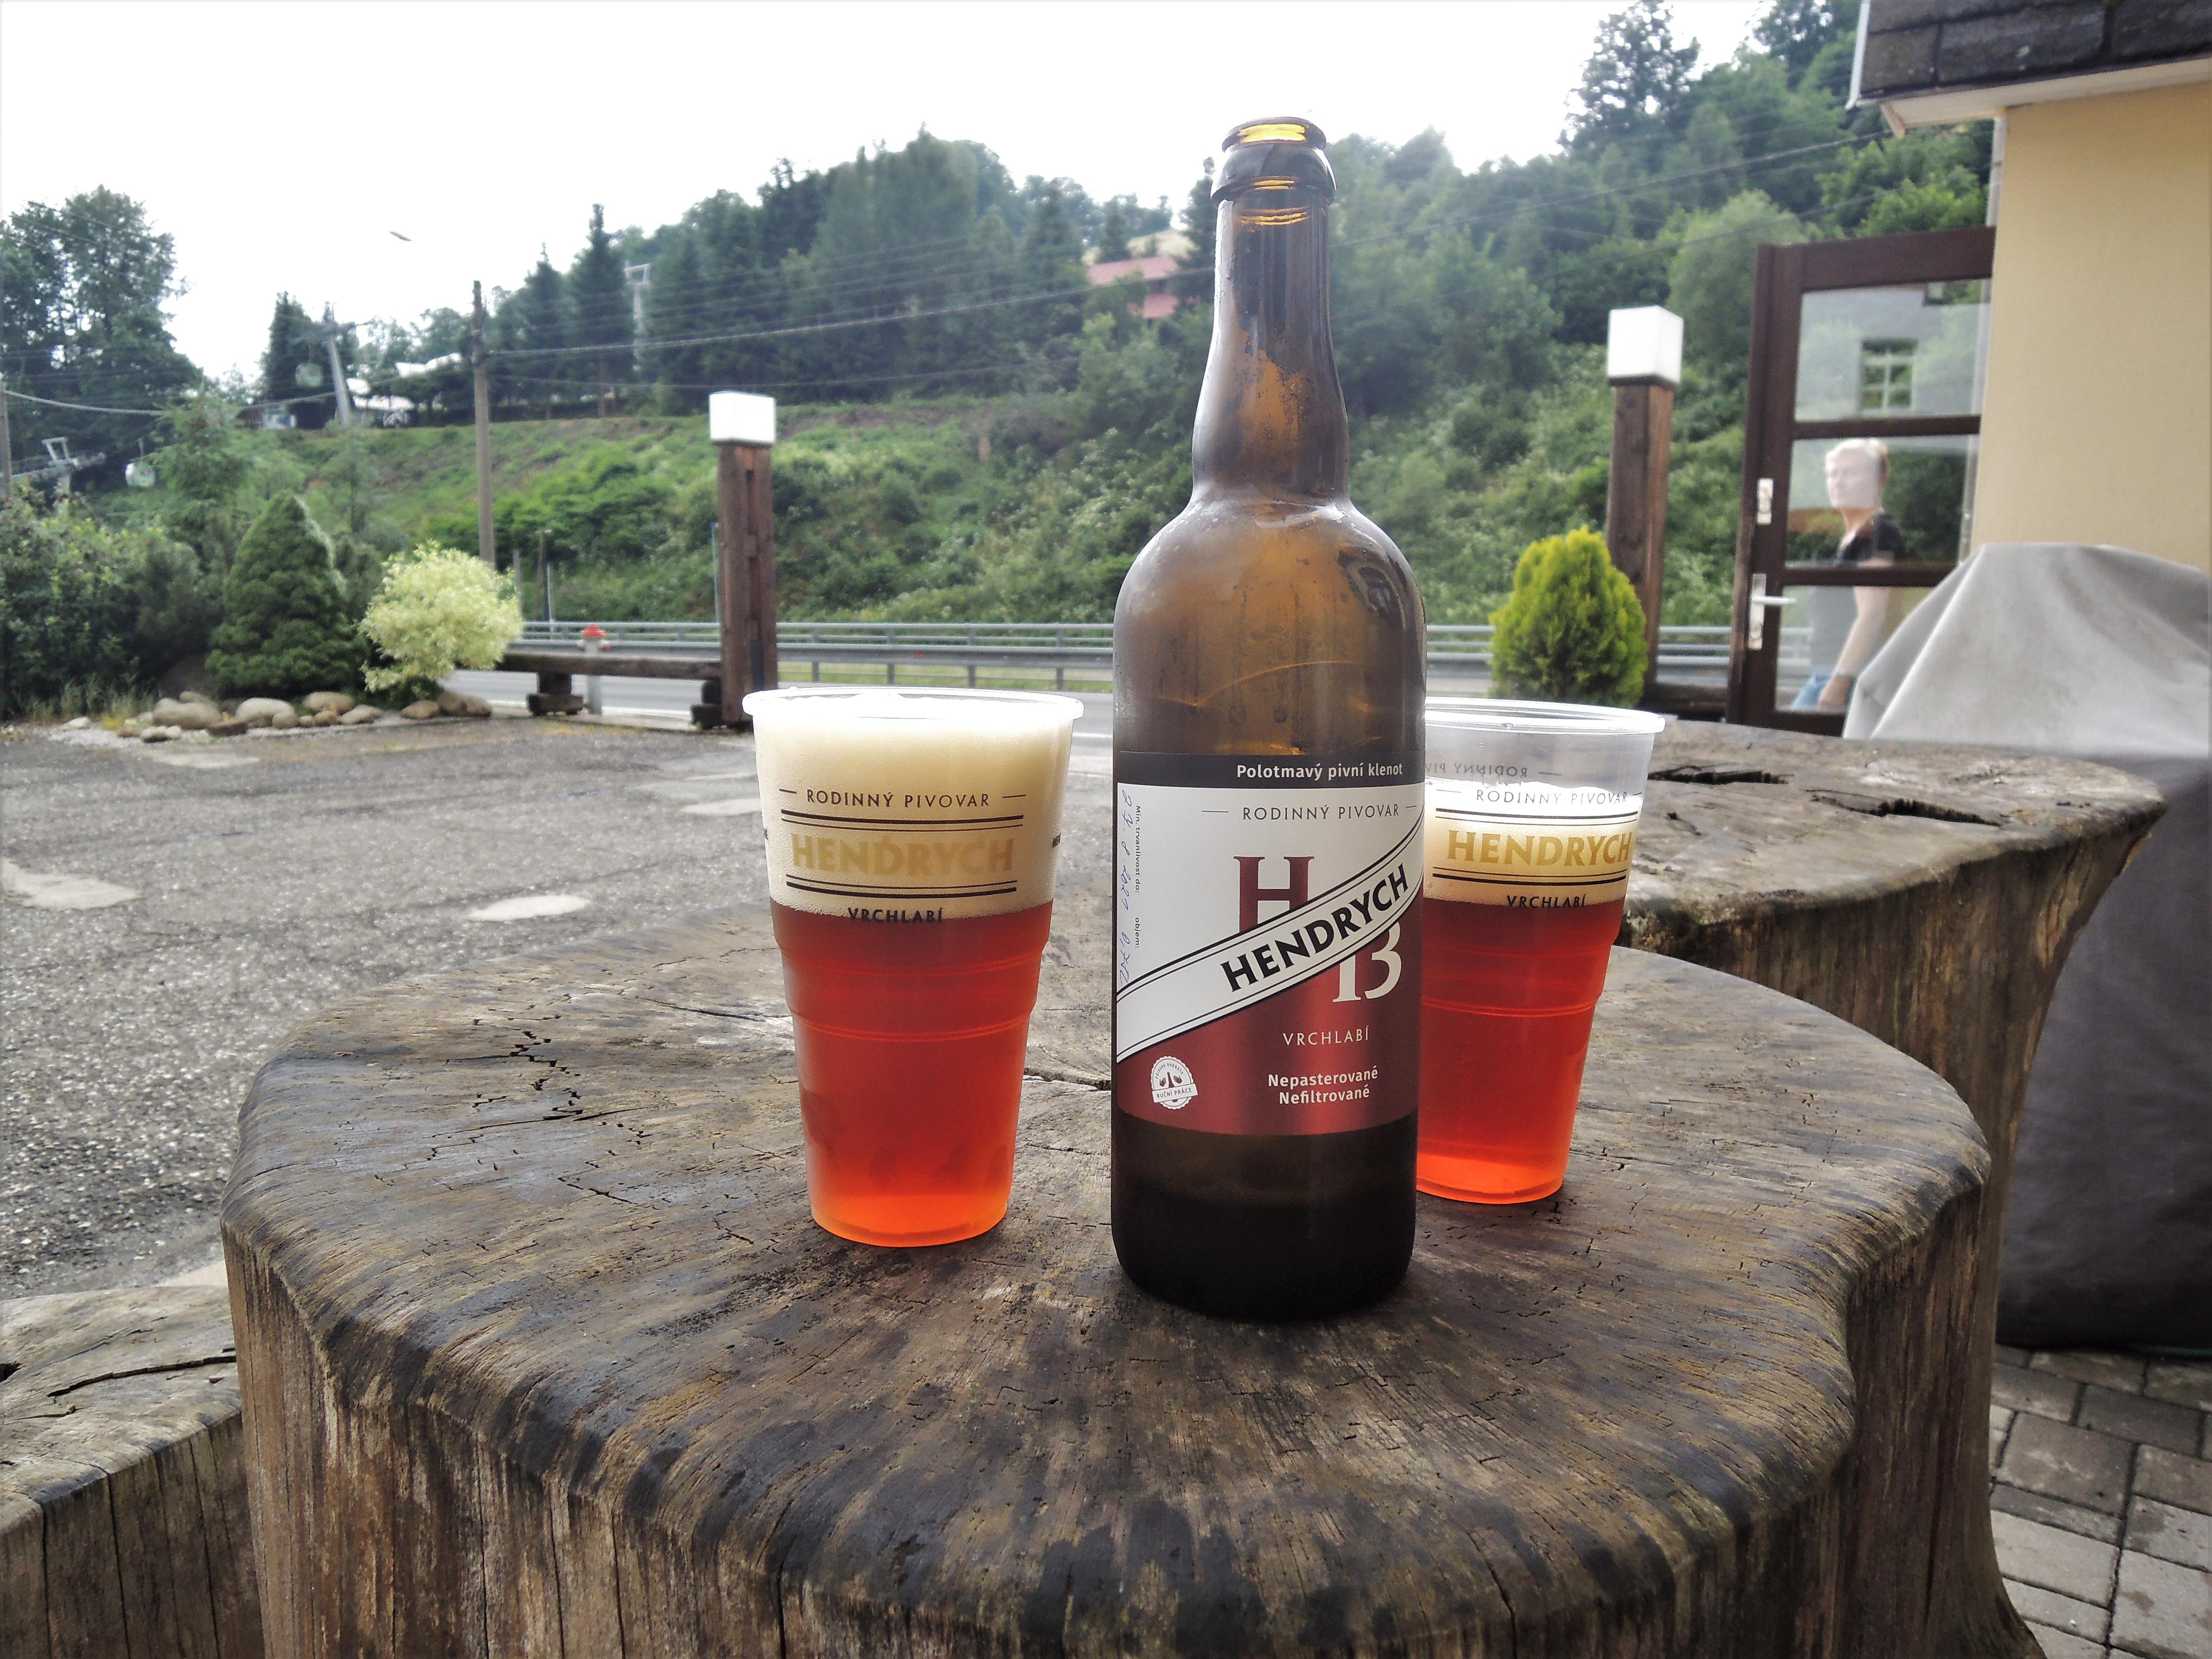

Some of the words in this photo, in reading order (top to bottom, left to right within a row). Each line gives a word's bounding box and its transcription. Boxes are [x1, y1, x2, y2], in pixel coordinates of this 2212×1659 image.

[1237, 763, 1322, 781] Polotmavý
[1328, 762, 1364, 780] pivní
[1368, 763, 1403, 776] klenot
[806, 789, 894, 808] RODINNÝ
[904, 792, 990, 808] PIVOVAR
[1570, 791, 1628, 805] PIVOVAR
[1243, 805, 1329, 821] RODINNÝ
[1338, 803, 1400, 818] PIVOVAR
[790, 833, 1015, 877] HENDRYCH
[1447, 830, 1632, 867] HENDRYCH
[1234, 855, 1315, 934] H
[1506, 893, 1587, 908] VRCHLABÍ
[848, 907, 943, 923] VRCHLABÍ
[1219, 862, 1410, 993] HENDRYCH
[1332, 921, 1402, 1003] 13
[1282, 1025, 1369, 1046] VRCHLABÍ
[1268, 1065, 1379, 1090] Nepasterované
[1156, 1089, 1173, 1098] RUČNÍ
[1174, 1087, 1193, 1095] PRÁCE
[1279, 1084, 1370, 1105] Nefiltrované
